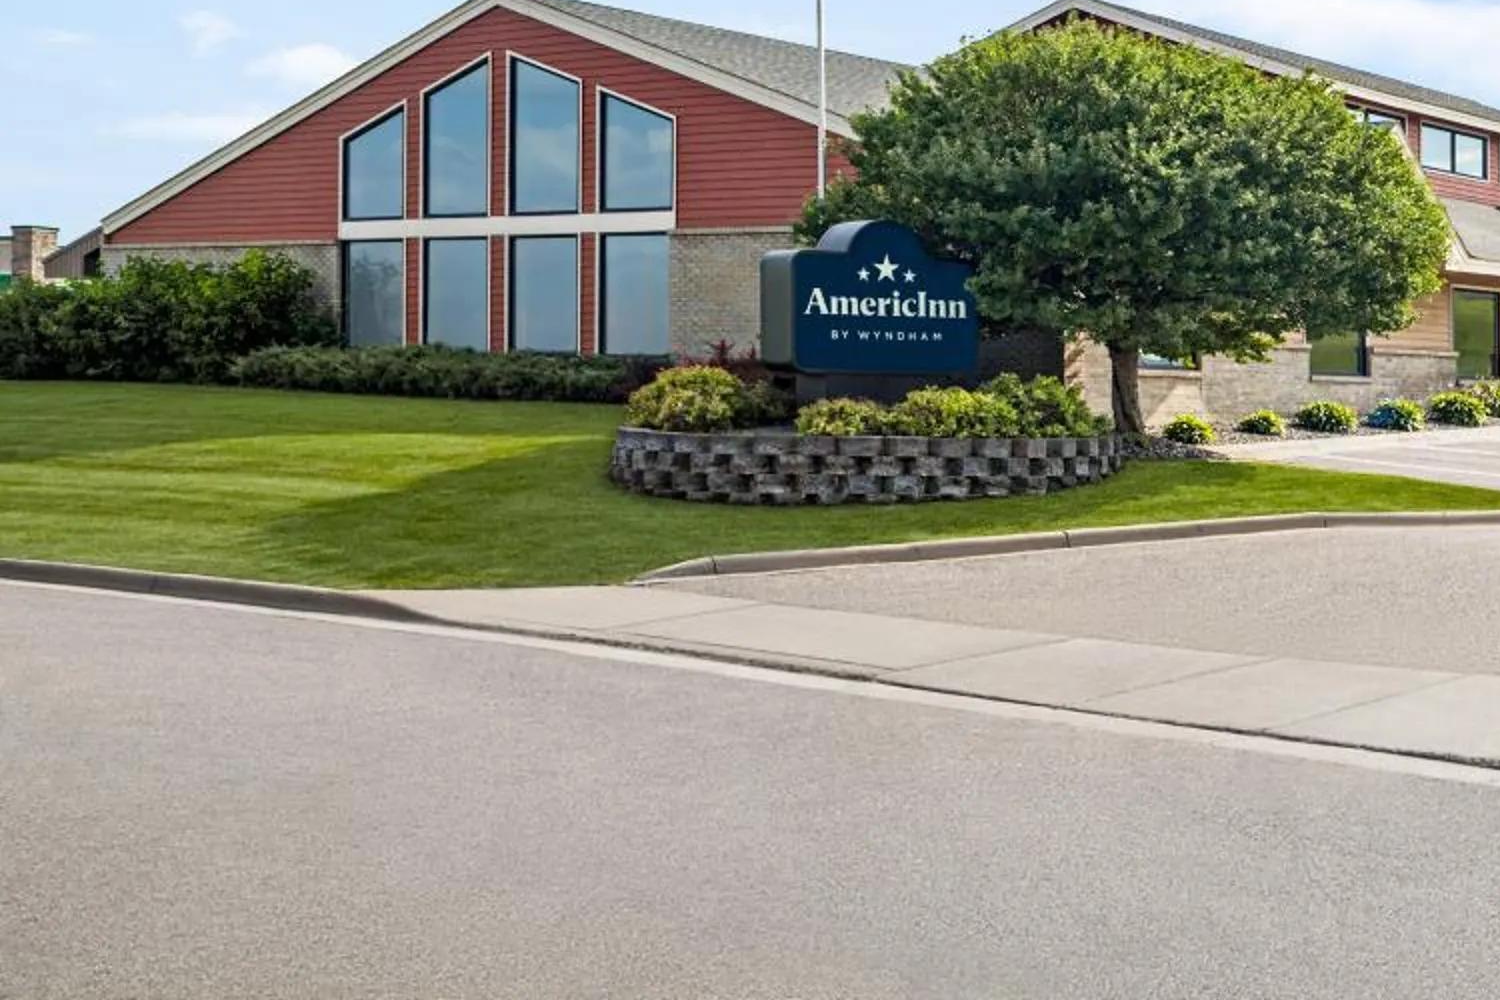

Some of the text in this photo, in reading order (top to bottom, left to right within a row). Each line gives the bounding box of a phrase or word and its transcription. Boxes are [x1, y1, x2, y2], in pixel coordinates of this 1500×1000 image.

[803, 287, 967, 319] AmericInn
[831, 329, 943, 341] BY WYNDHAM
